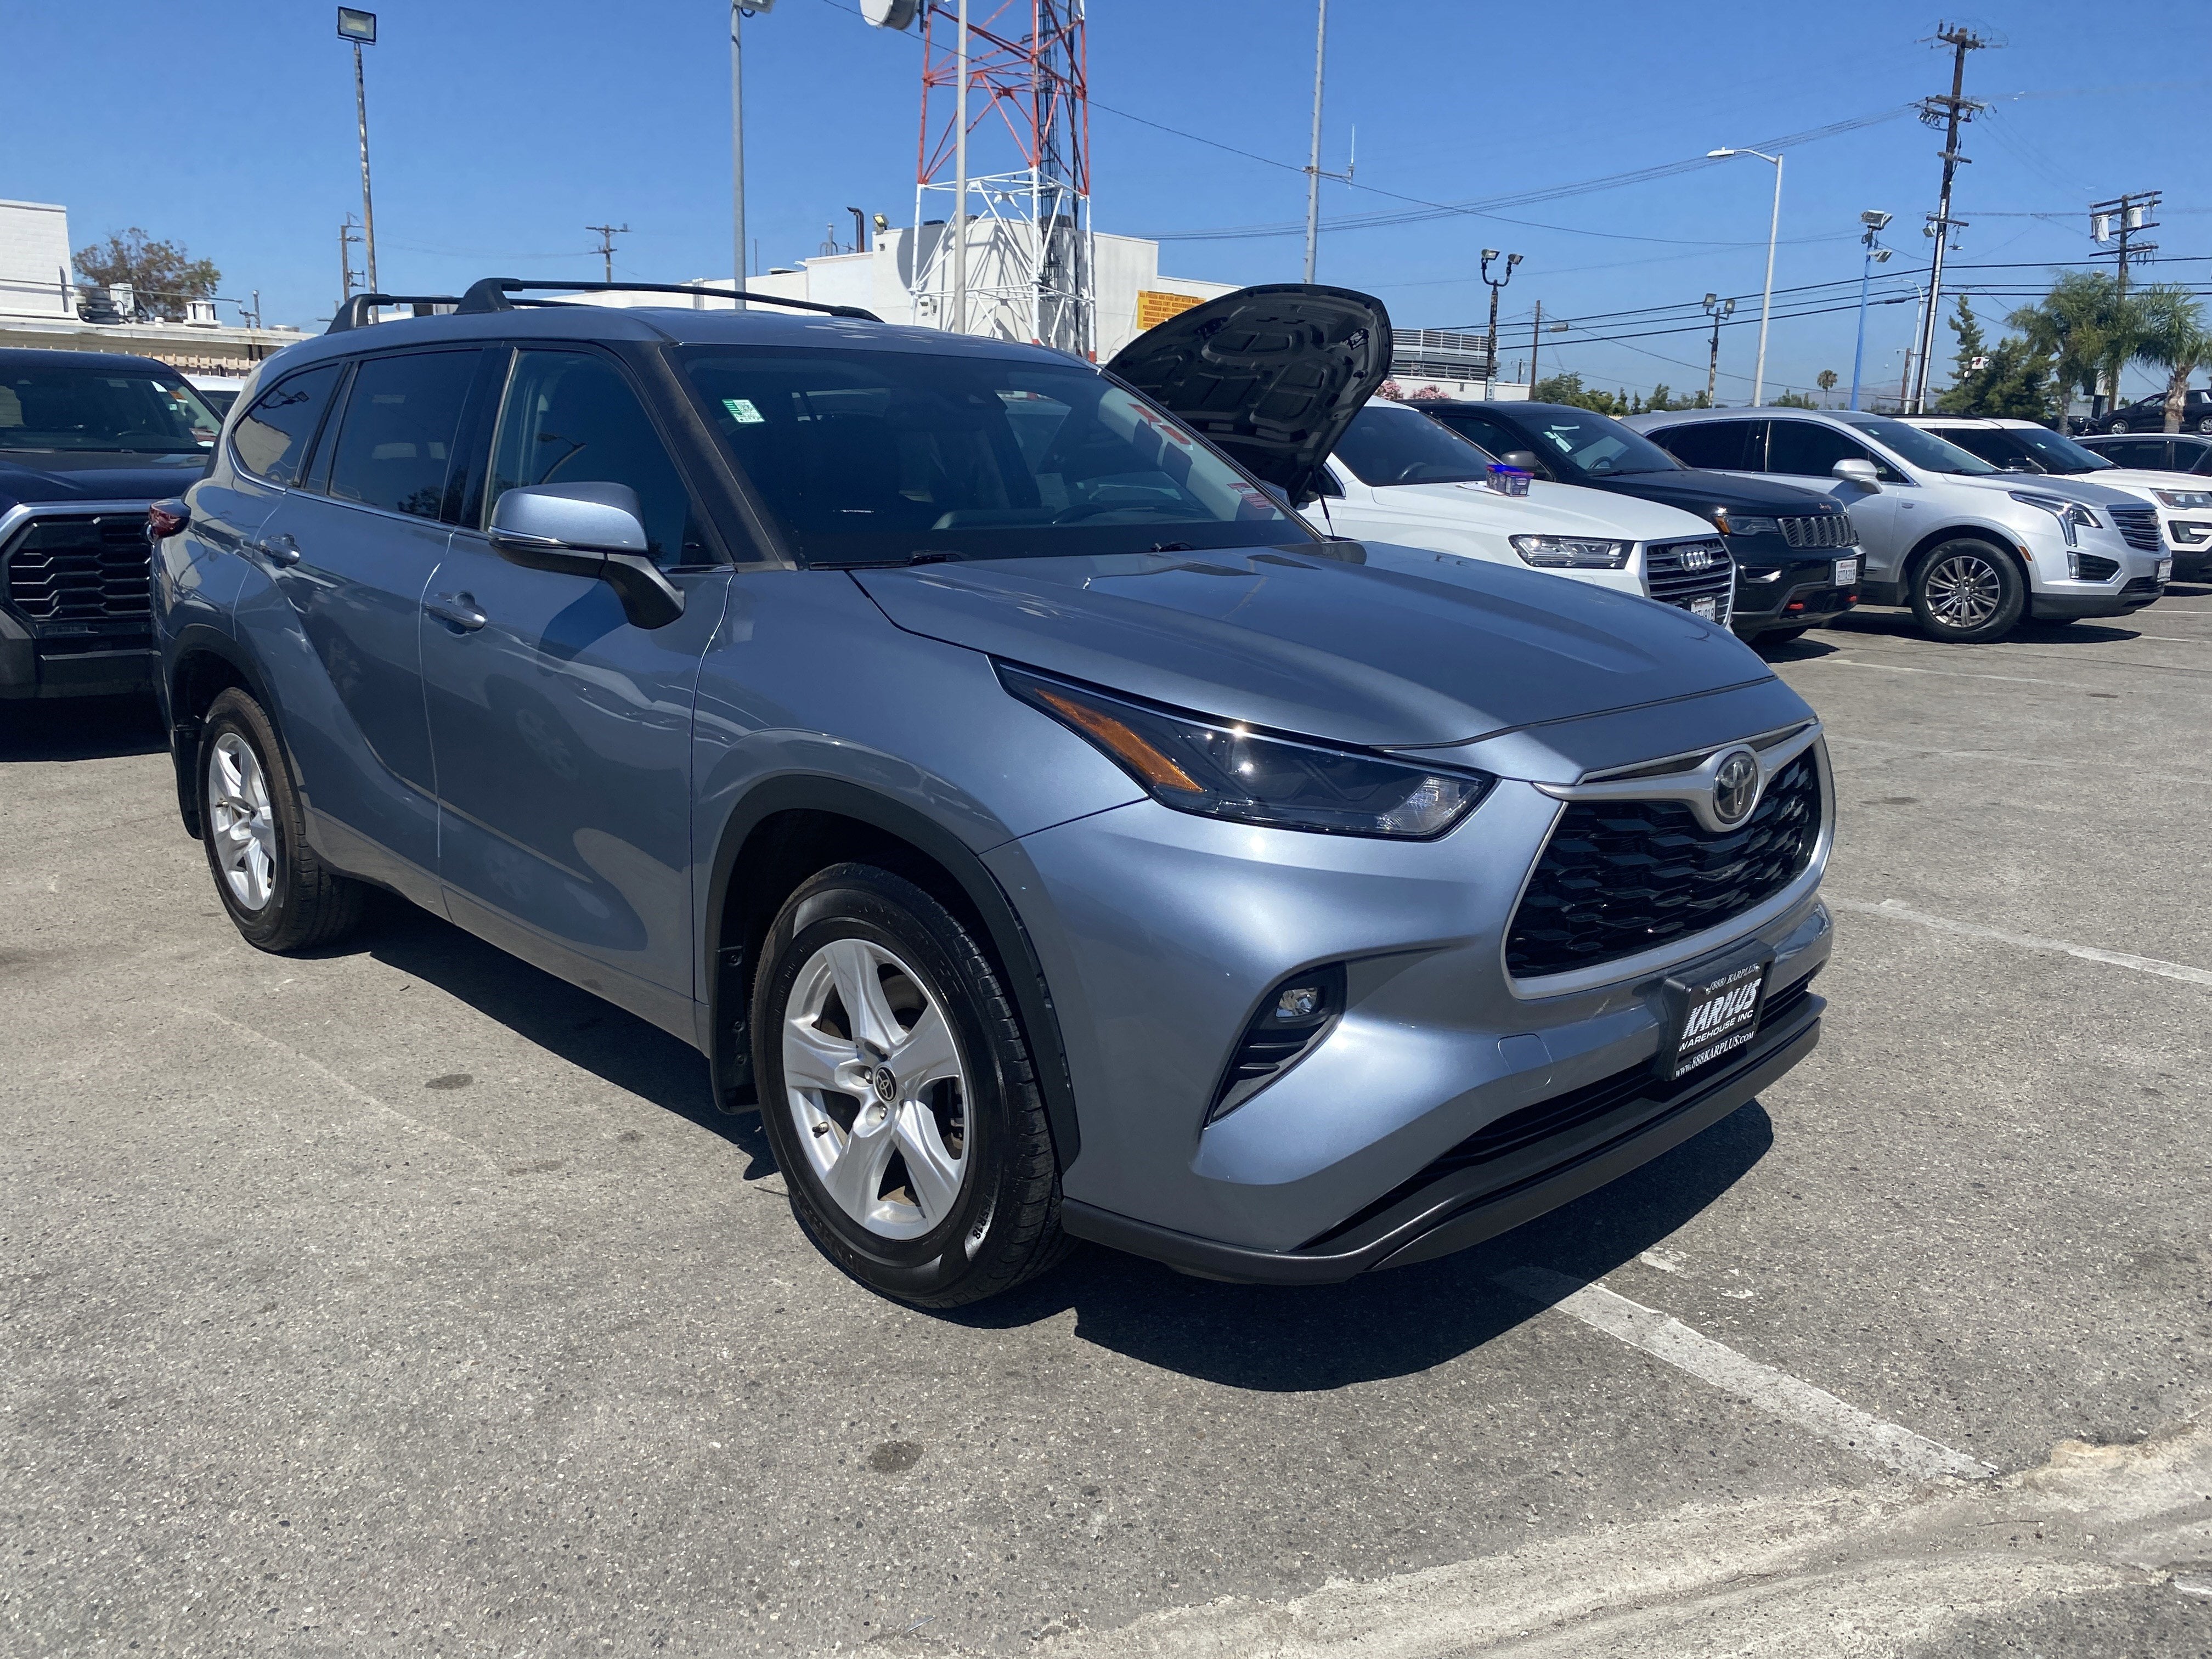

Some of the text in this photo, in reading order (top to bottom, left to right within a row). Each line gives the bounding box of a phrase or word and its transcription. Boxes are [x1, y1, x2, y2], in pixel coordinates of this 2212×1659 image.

[1678, 1009, 1754, 1052] WAREHOUSE INC
[1681, 978, 1762, 1040] KARPLUS
